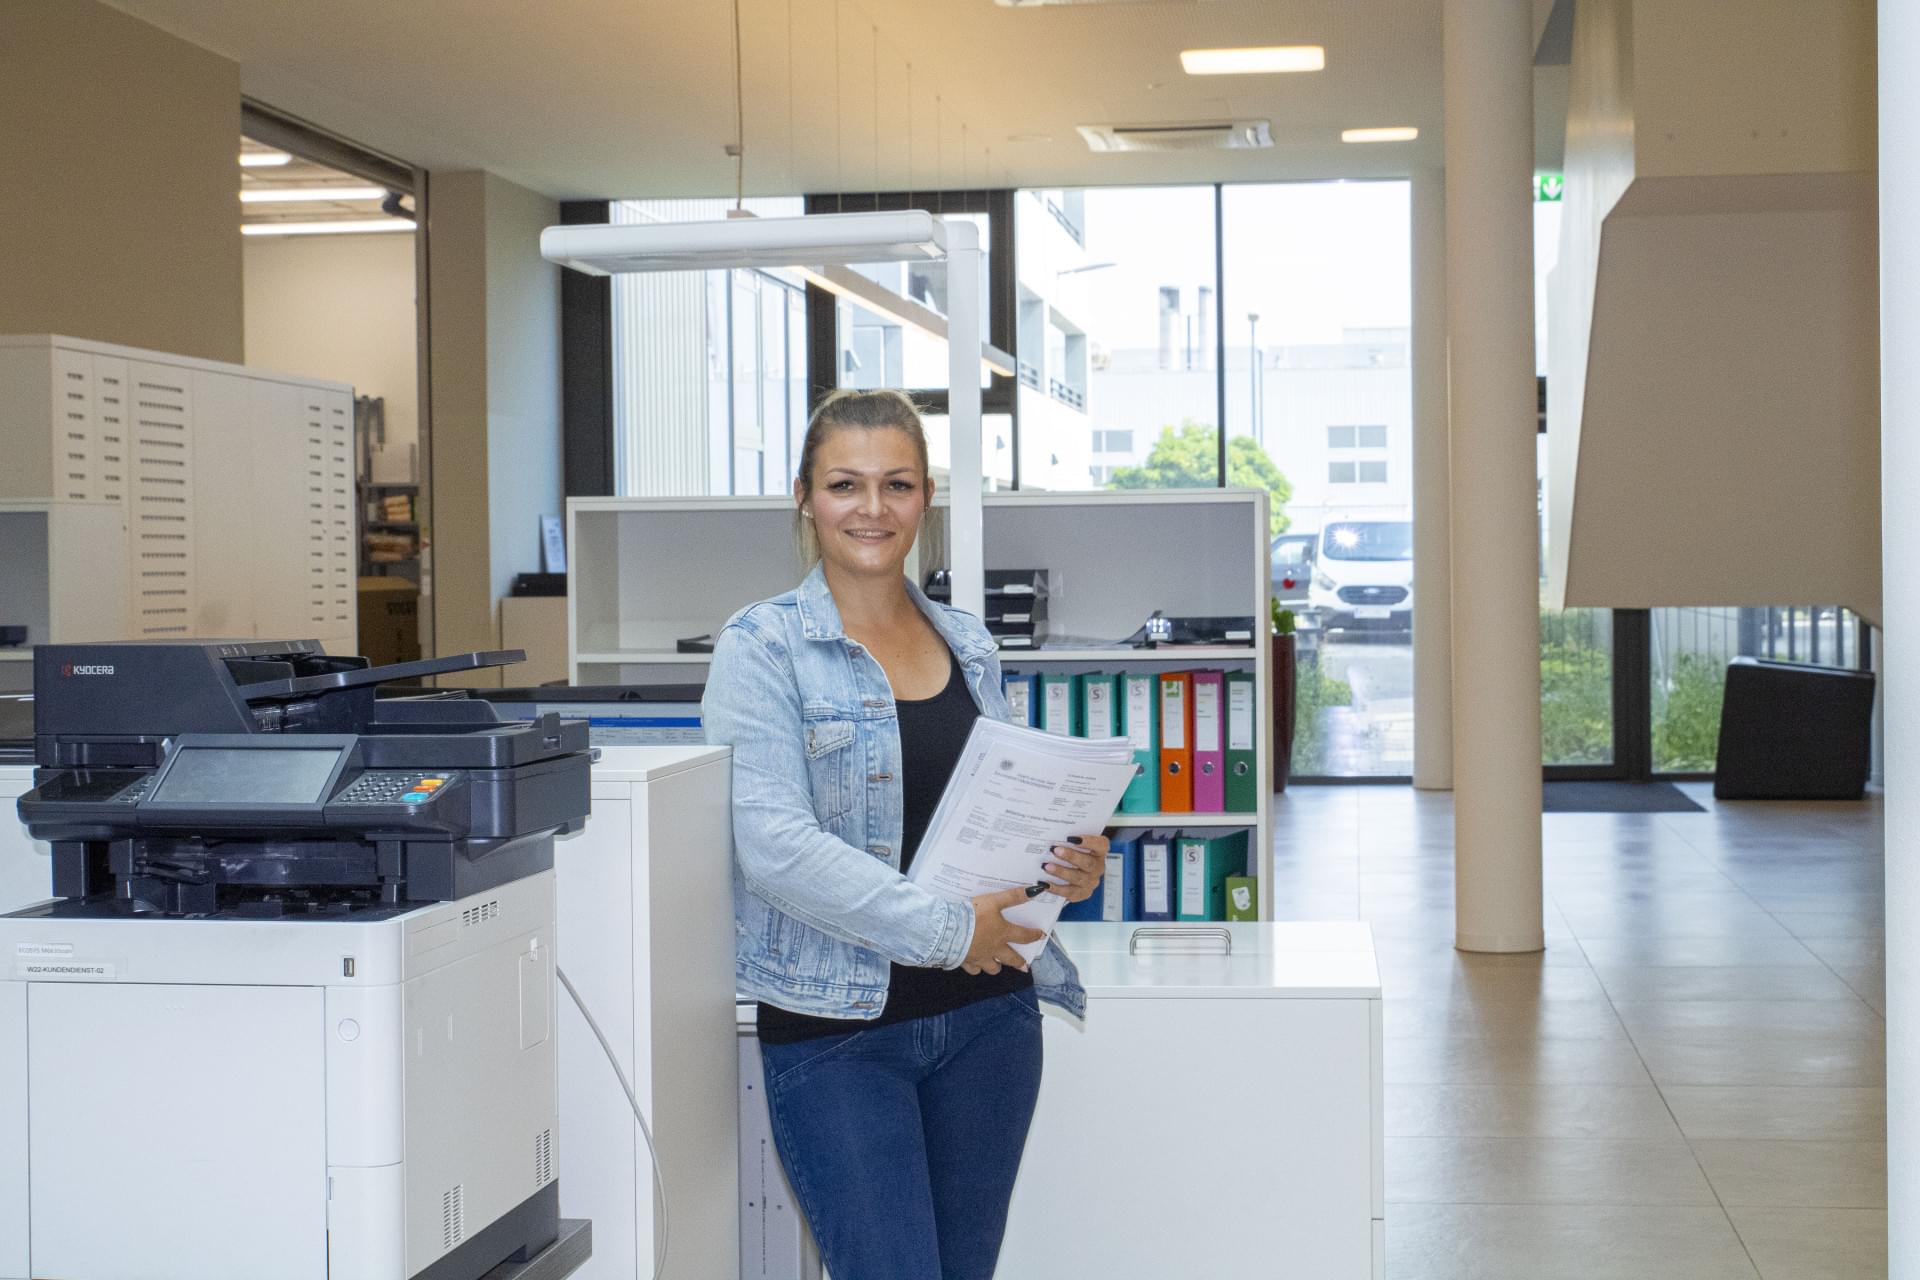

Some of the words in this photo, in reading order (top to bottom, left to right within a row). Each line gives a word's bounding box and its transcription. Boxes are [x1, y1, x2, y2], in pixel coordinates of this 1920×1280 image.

[73, 665, 114, 675] KYOCERA
[1092, 688, 1101, 700] S
[1188, 851, 1196, 862] S
[27, 966, 104, 974] W22-KUNDENDIENST-02
